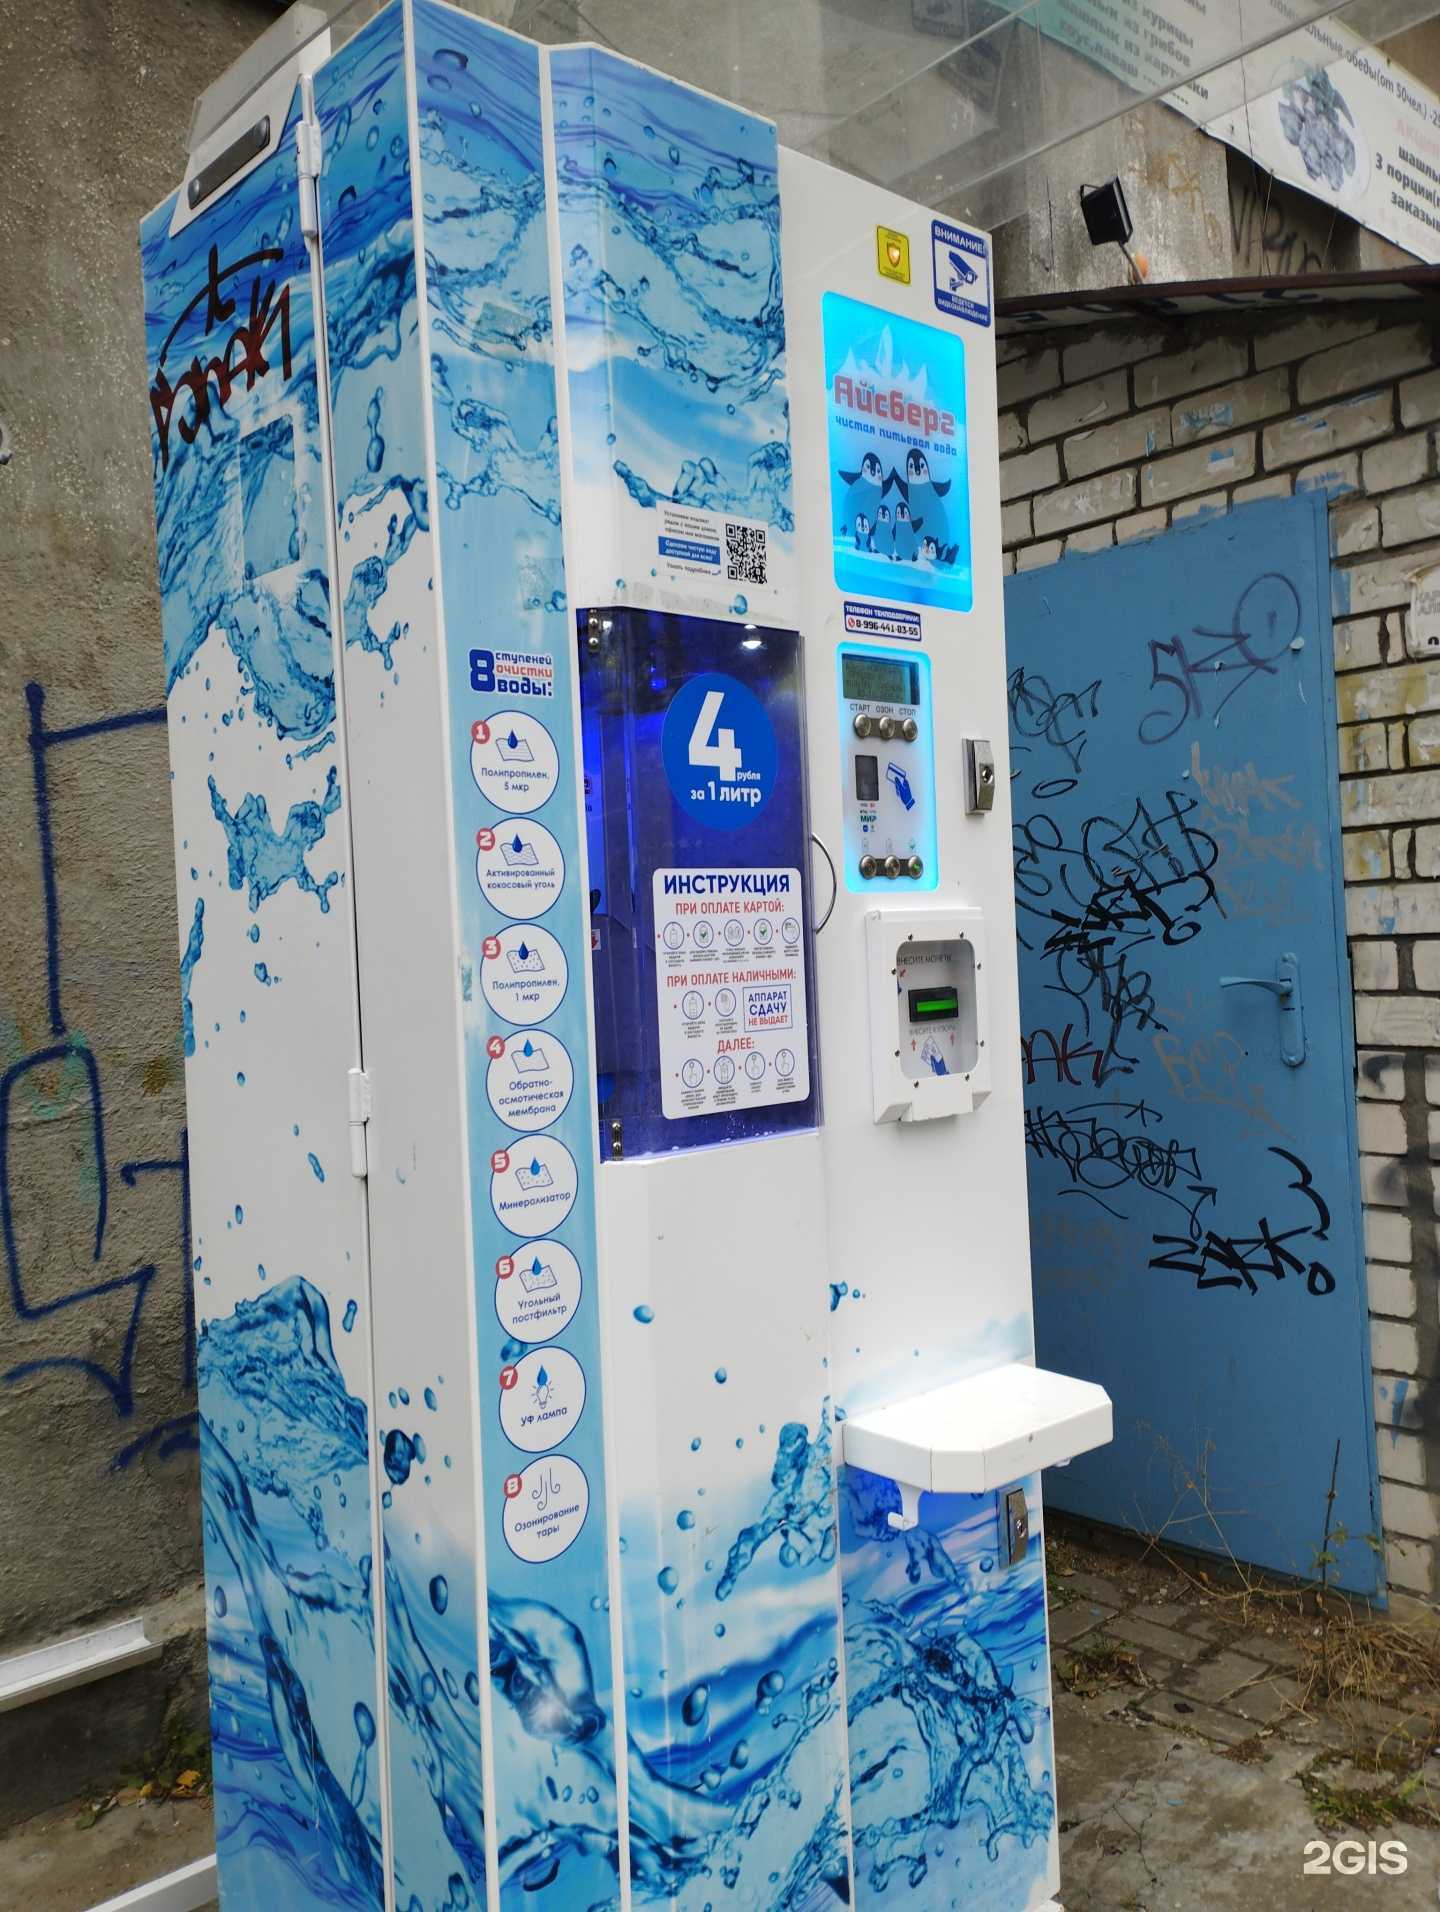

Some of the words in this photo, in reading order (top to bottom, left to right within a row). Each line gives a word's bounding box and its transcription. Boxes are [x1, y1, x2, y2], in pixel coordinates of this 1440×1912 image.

[1142, 6, 1194, 49] курицы
[1375, 152, 1383, 170] 3
[834, 374, 956, 437] Айсберг
[835, 415, 875, 434] чистая
[879, 427, 931, 450] питьевая
[934, 444, 957, 457] вода
[846, 605, 873, 616] ТЕЛЕФОН
[495, 651, 552, 665] ступеней
[470, 649, 495, 692] 8
[496, 664, 553, 678] очистки
[497, 676, 553, 697] воды:
[849, 703, 870, 713] СТАРТ
[876, 705, 894, 714] ОЗОН
[899, 707, 917, 716] СТОП
[688, 691, 743, 782] 4
[737, 770, 761, 781] рубля
[504, 782, 509, 791] 5
[511, 783, 530, 793] мкр
[690, 788, 705, 800] за
[707, 781, 716, 801] 1
[719, 786, 762, 808] литр
[486, 868, 556, 880] Активированный
[487, 880, 533, 889] кокосовый
[535, 881, 556, 890] уголь
[664, 874, 790, 896] ИНСТРУКЦИЯ
[675, 902, 697, 916] ПРИ
[700, 901, 740, 915] ОПЛАТЕ
[743, 898, 785, 913] КАРТОЙ:
[667, 975, 688, 988] ПРИ
[691, 972, 729, 986] ОПЛАТЕ
[732, 967, 797, 983] НАЛИЧНЫМИ:
[522, 992, 540, 1002] мкр
[748, 991, 788, 1003] АППАРАТ
[749, 1001, 787, 1017] СДАЧУ
[748, 1017, 759, 1027] НЕ
[760, 1014, 789, 1025] ВЫДАЕТ
[717, 1037, 755, 1054] ДАЛЕЕ:
[498, 1090, 564, 1105] осмотическая
[508, 1104, 556, 1117] мембрана
[518, 1292, 561, 1310] Угольный
[512, 1305, 567, 1325] постфильтр
[536, 1406, 568, 1423] лампа
[514, 1504, 580, 1533] Озонирование
[536, 1525, 560, 1539] тары
